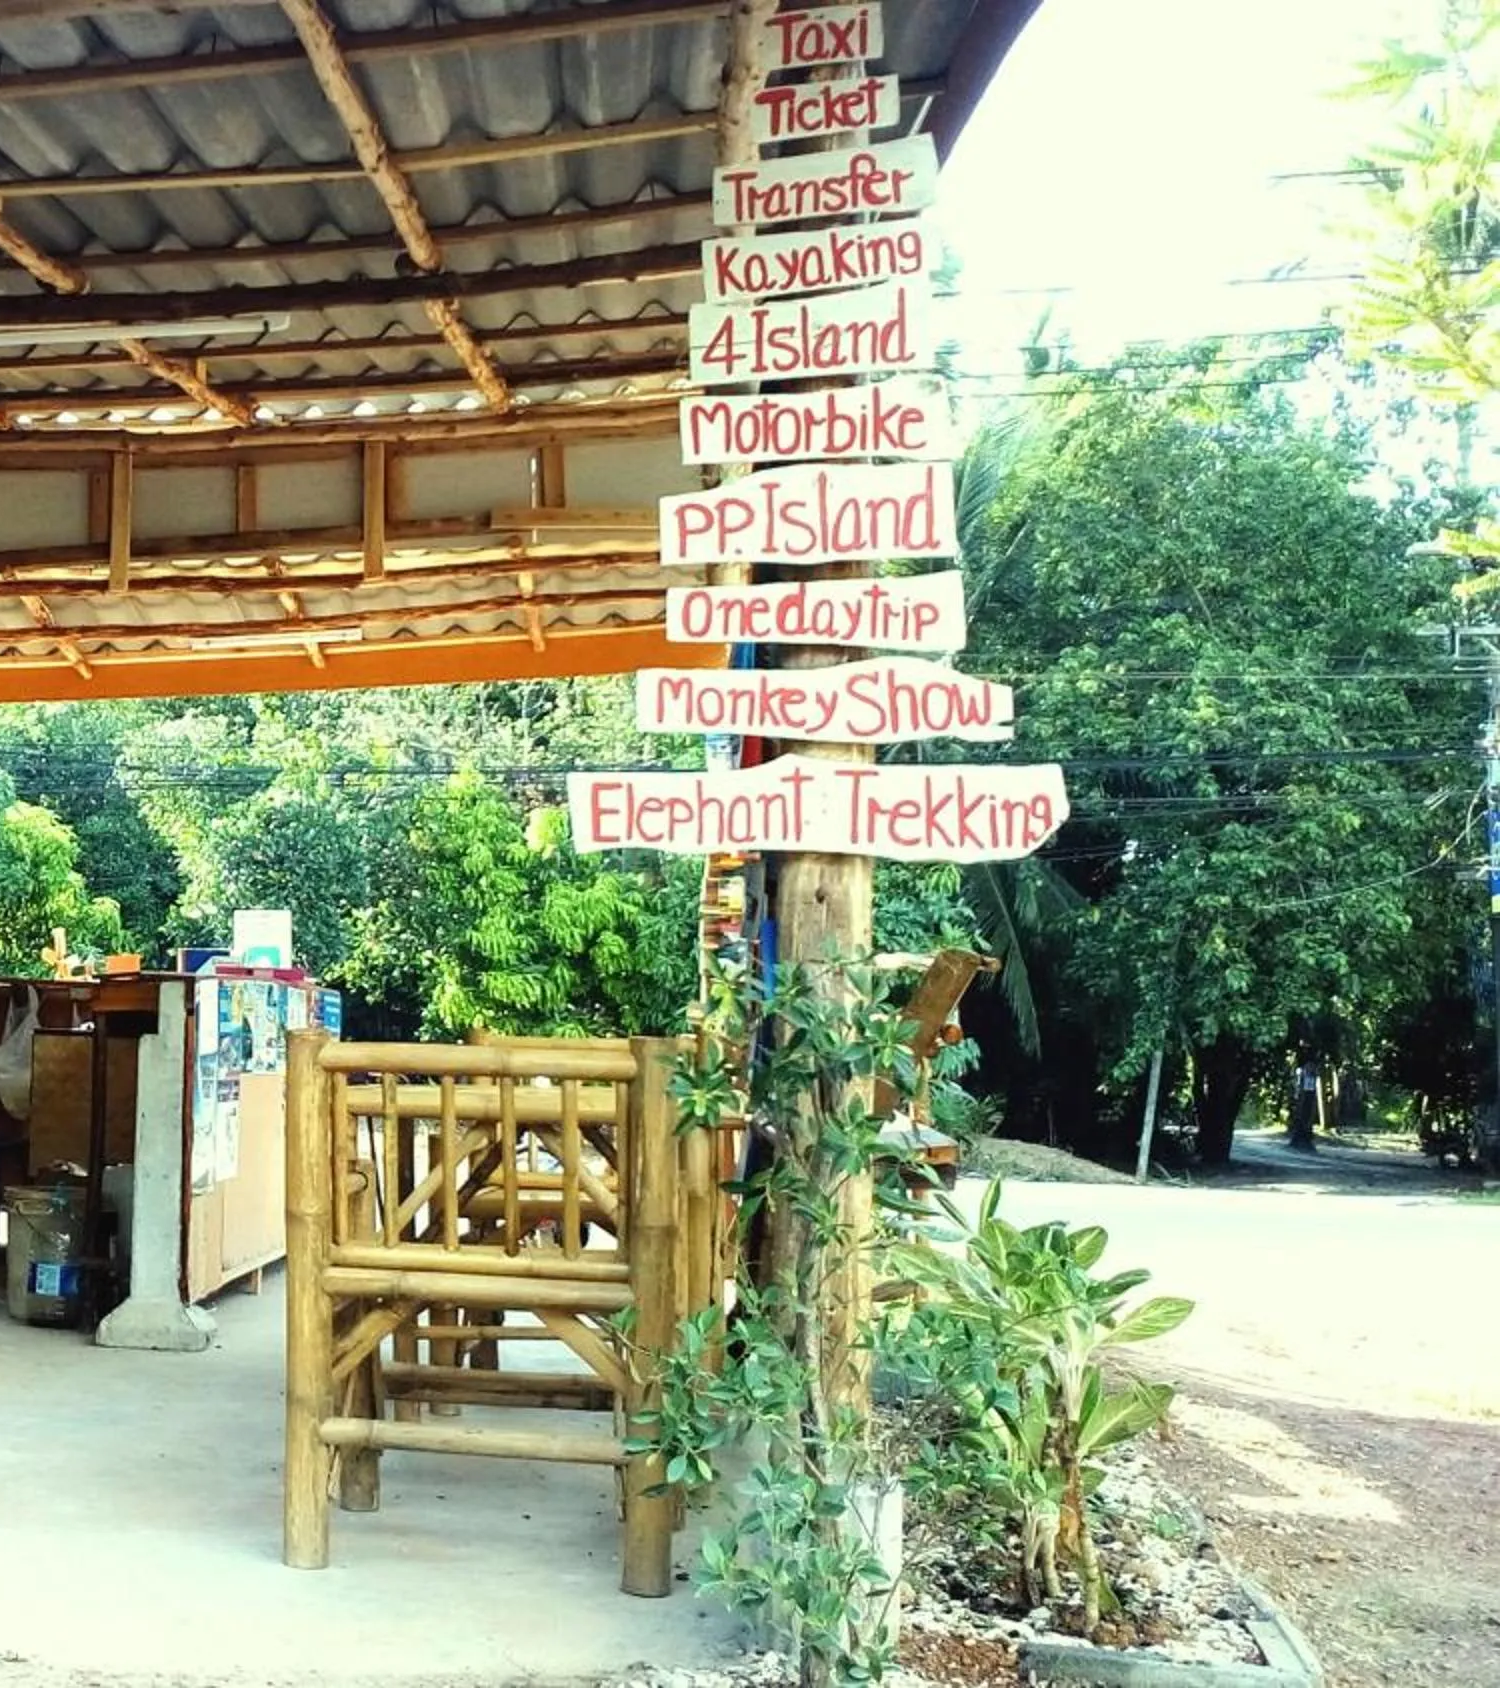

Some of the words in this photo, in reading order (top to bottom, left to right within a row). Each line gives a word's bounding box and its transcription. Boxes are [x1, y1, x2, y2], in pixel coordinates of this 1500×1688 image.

[764, 9, 870, 66] Taxi
[754, 77, 886, 137] Ticket
[721, 152, 915, 224] Transfer
[714, 229, 922, 297] Kayaking
[689, 385, 927, 456] Motorbike
[655, 675, 838, 734] Monkey
[845, 668, 993, 737] Show
[589, 766, 814, 845] Elephant
[834, 768, 1054, 850] Trekking
